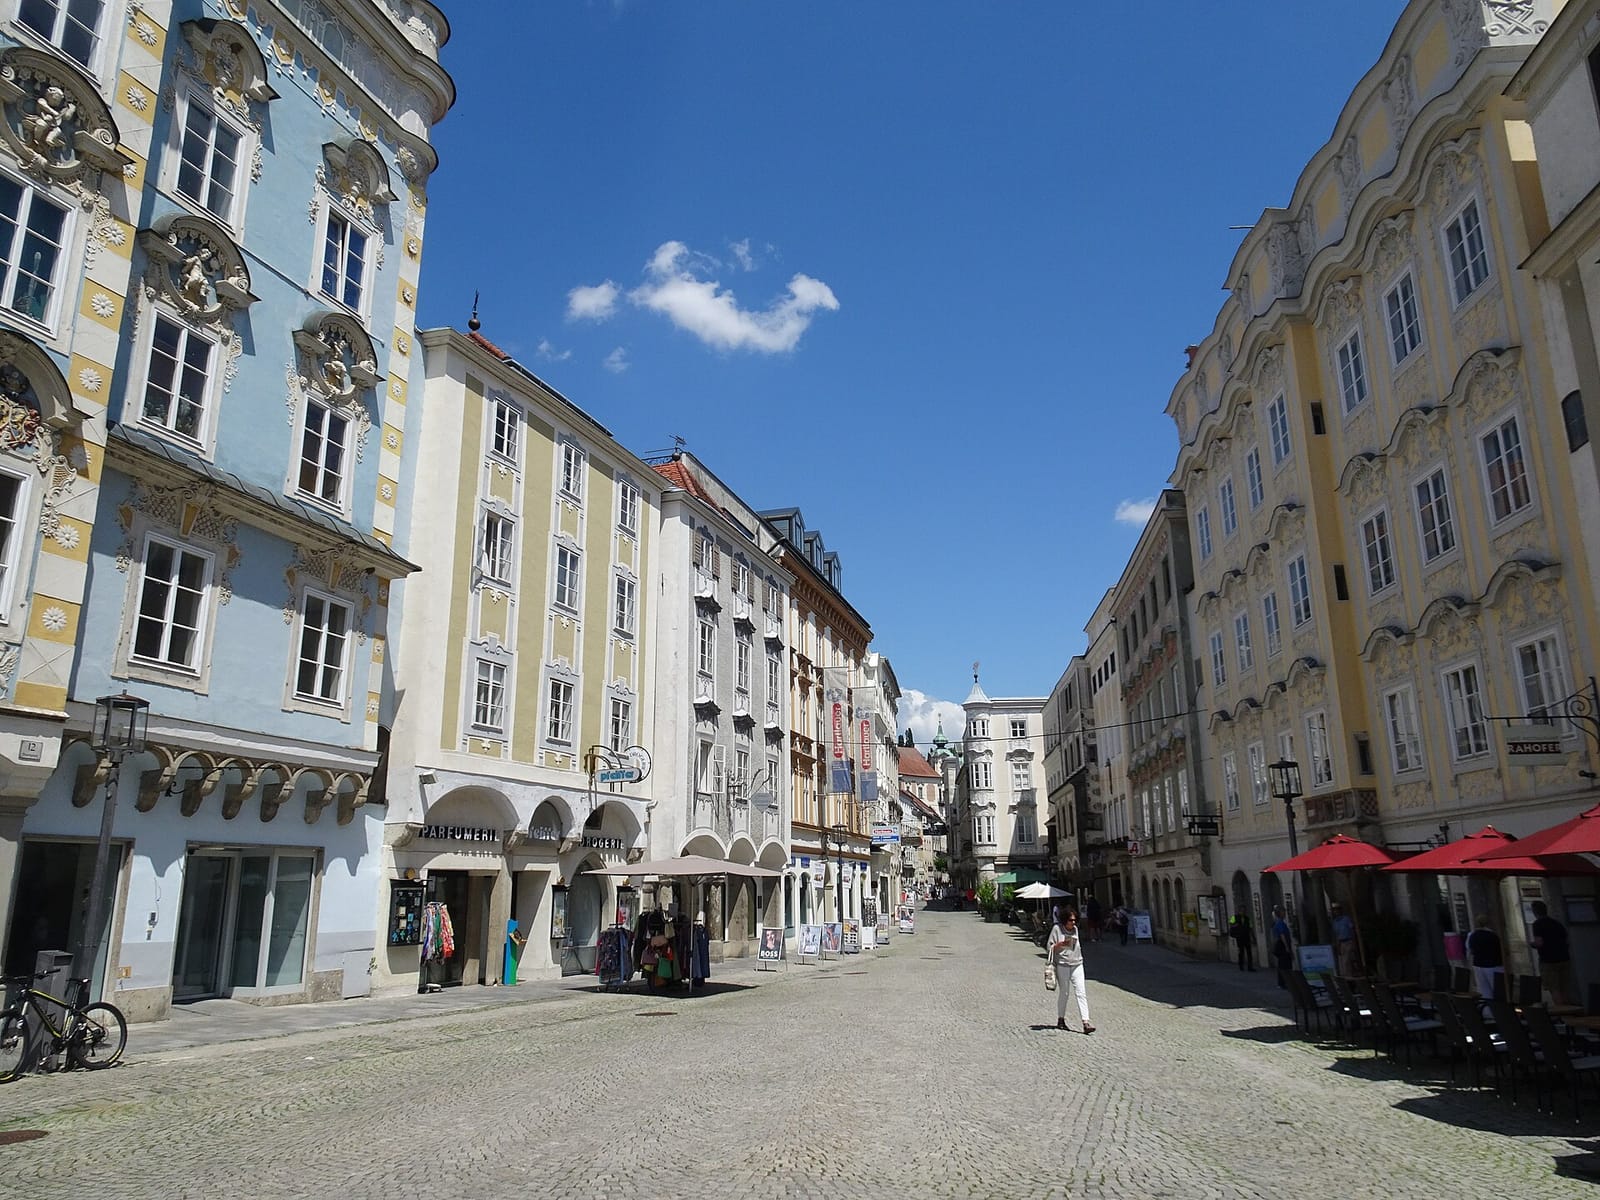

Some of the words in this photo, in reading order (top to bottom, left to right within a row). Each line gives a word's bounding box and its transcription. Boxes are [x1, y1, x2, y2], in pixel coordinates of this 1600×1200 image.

[834, 706, 843, 754] Hartlauer
[28, 742, 36, 752] 12
[863, 723, 871, 766] Hartlauer
[1506, 744, 1560, 753] RAHOFER
[760, 950, 778, 958] BOSS
